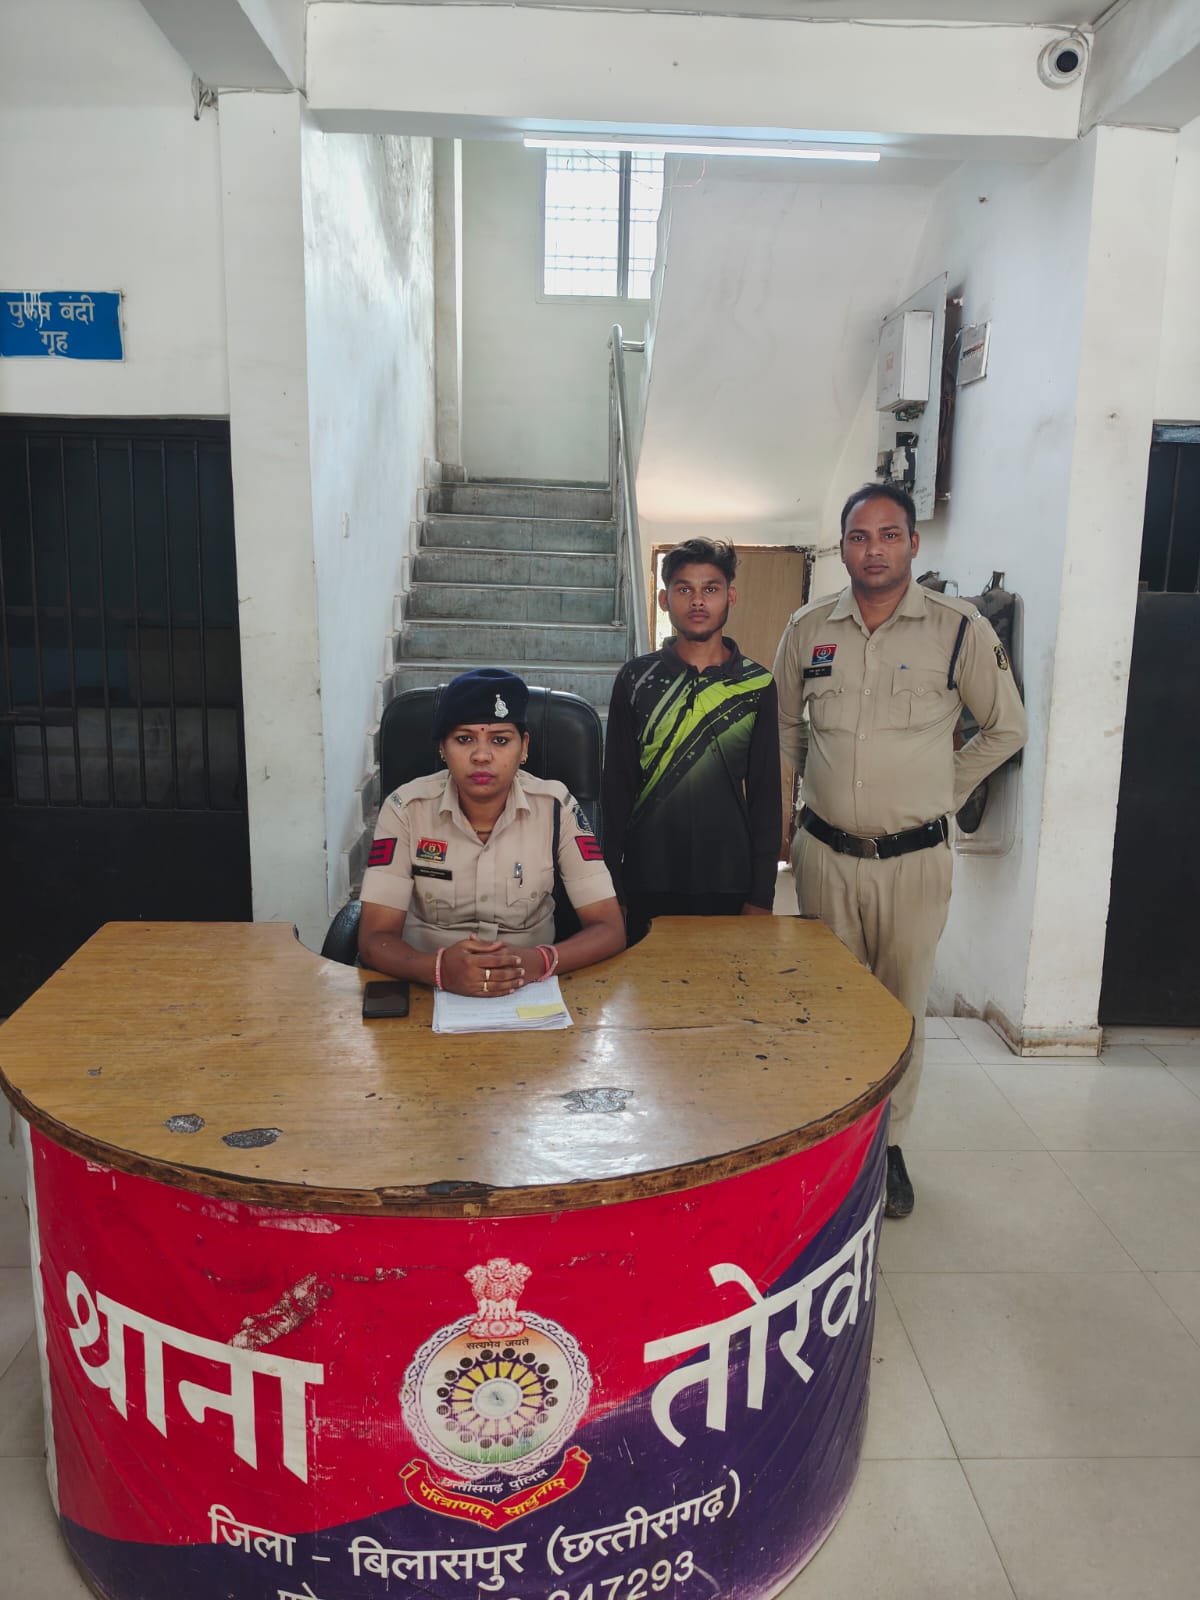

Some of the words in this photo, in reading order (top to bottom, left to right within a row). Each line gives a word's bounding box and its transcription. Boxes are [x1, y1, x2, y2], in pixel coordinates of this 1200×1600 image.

[58, 295, 95, 325] बंदी
[38, 330, 69, 356] गृह
[66, 1271, 324, 1484] थाना
[643, 1197, 881, 1448] तोरवा
[509, 1468, 549, 1491] पुलिस
[419, 1480, 495, 1520] परित्राणाय
[207, 1503, 297, 1566] जिला
[348, 1535, 528, 1591] बिलासपुर
[547, 1469, 741, 1575] (छत्तीसगढ़)
